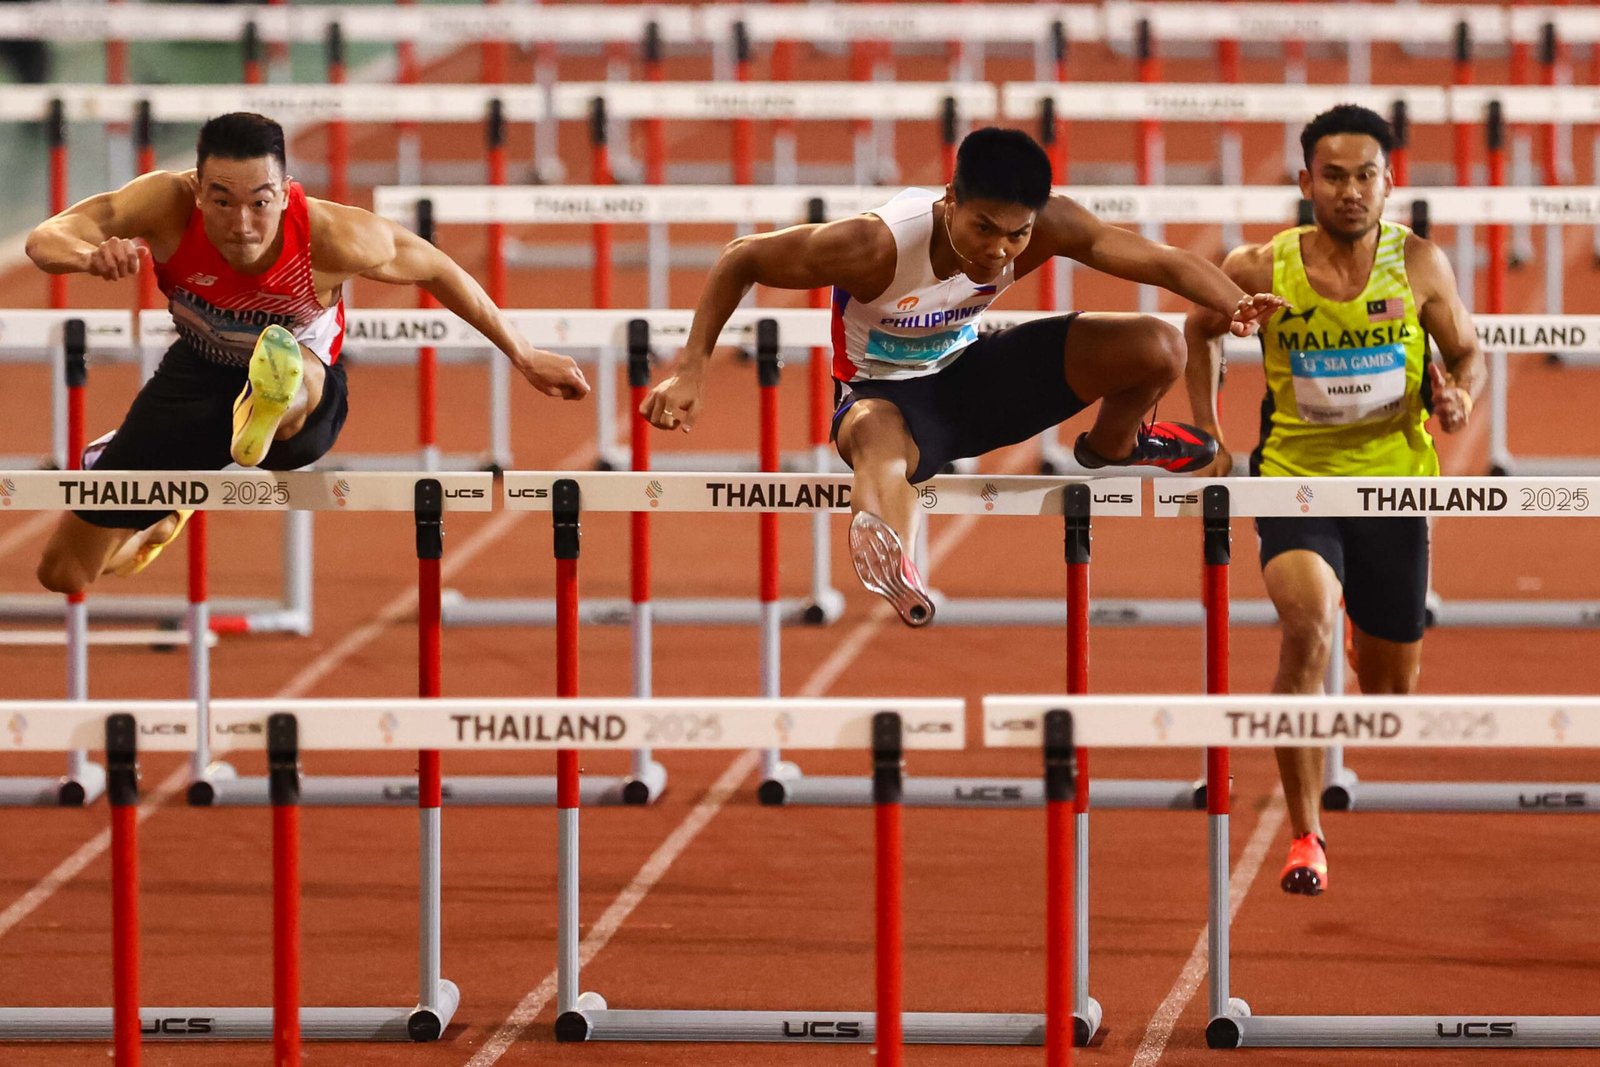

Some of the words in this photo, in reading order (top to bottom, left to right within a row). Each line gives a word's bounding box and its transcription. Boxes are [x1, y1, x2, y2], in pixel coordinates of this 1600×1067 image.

[345, 320, 447, 340] AILAND
[1277, 323, 1410, 350] MALAYSIA
[1475, 325, 1586, 345] HAILAND
[1324, 356, 1348, 371] SEA
[1350, 352, 1394, 371] GAMES
[1327, 383, 1372, 395] HAIZAD
[59, 481, 209, 505] THAILAND
[221, 481, 291, 506] 2025
[445, 488, 485, 498] UCS
[508, 488, 548, 499] UCS
[706, 483, 852, 507] THAILAND
[1093, 494, 1134, 504] UCS
[1159, 494, 1198, 505] UCS
[1357, 487, 1508, 511] THAILAND
[1520, 487, 1590, 511] 2025
[450, 714, 626, 742] THAILAND
[1226, 711, 1402, 739] THAILAND
[953, 785, 1022, 801] UCS
[1518, 791, 1587, 808] UCS
[782, 1021, 861, 1038] UCS
[1436, 1022, 1518, 1038] UCS
